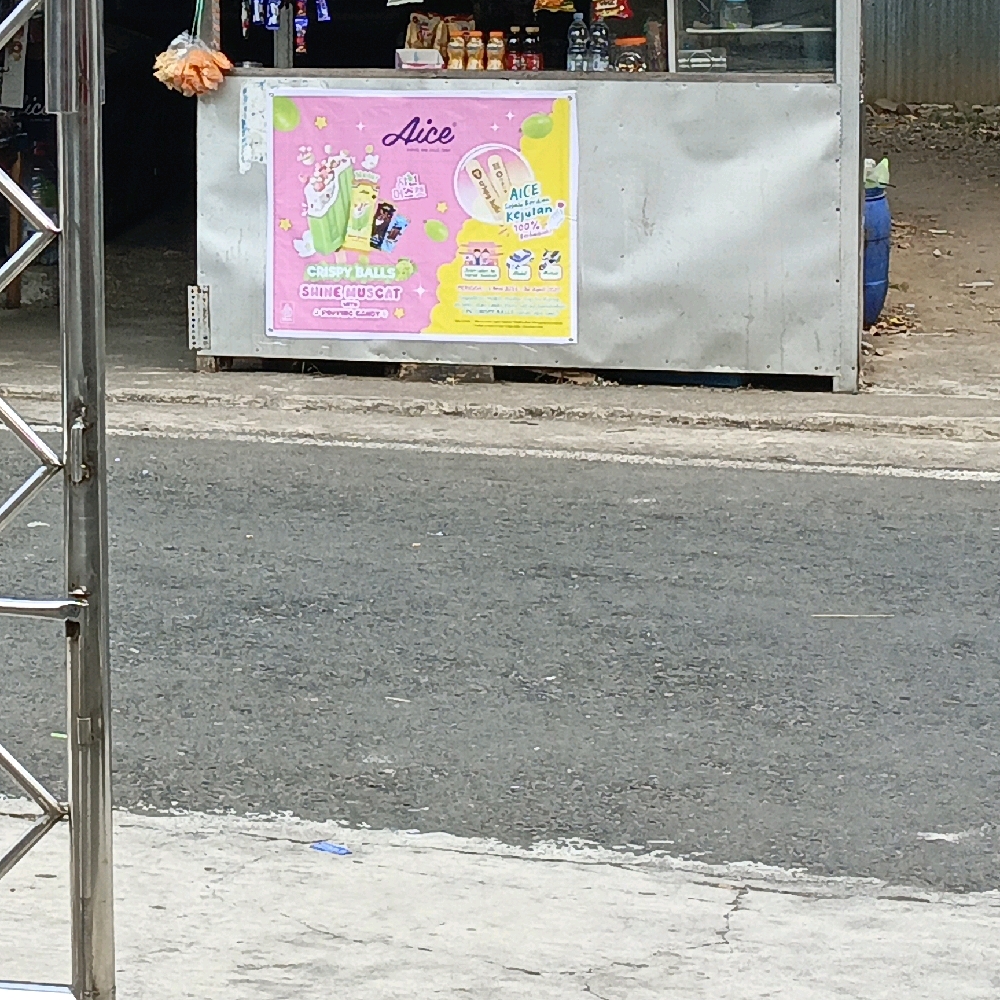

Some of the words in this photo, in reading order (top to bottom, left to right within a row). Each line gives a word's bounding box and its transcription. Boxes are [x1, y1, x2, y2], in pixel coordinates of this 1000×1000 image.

[382, 116, 455, 146] Aice
[509, 183, 540, 201] AICE
[307, 265, 352, 279] CRISPY
[355, 266, 396, 279] BALLS
[301, 286, 341, 298] SHINE
[345, 287, 401, 299] MUSCAT
